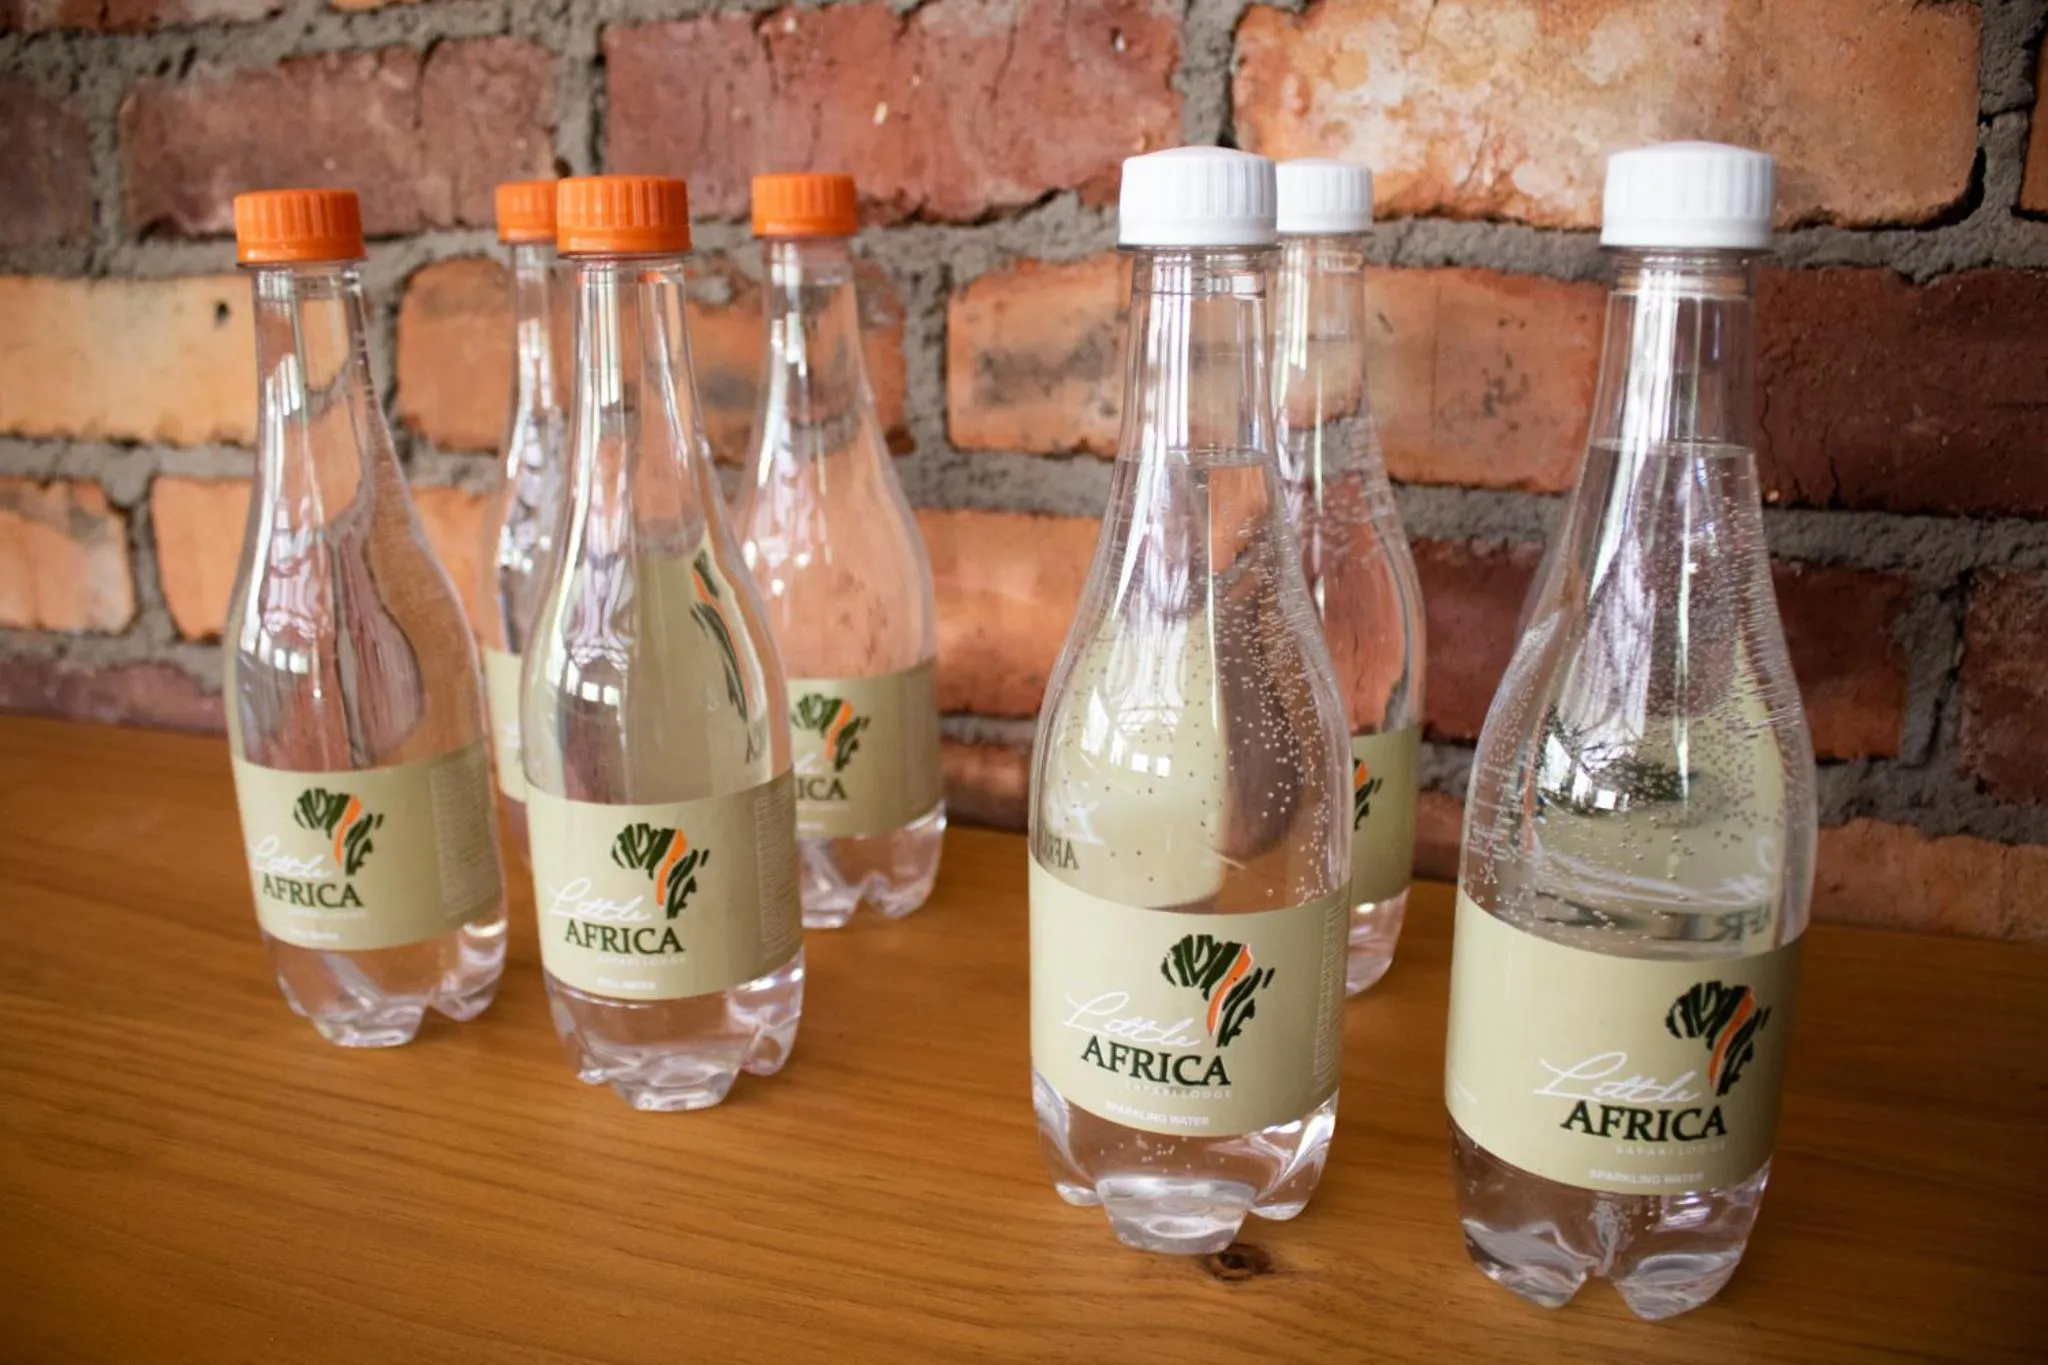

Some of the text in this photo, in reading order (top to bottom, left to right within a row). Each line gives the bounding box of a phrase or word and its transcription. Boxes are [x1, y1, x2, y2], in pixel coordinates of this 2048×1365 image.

[798, 778, 847, 801] ICA
[262, 873, 364, 908] AFRICA
[564, 919, 686, 955] AFRICA
[1081, 1035, 1231, 1087] AFRICA
[1105, 1100, 1210, 1126] SPARKLING WATER
[1560, 1100, 1727, 1142] AFRICA
[1588, 1168, 1705, 1185] SPARKLING WATER
